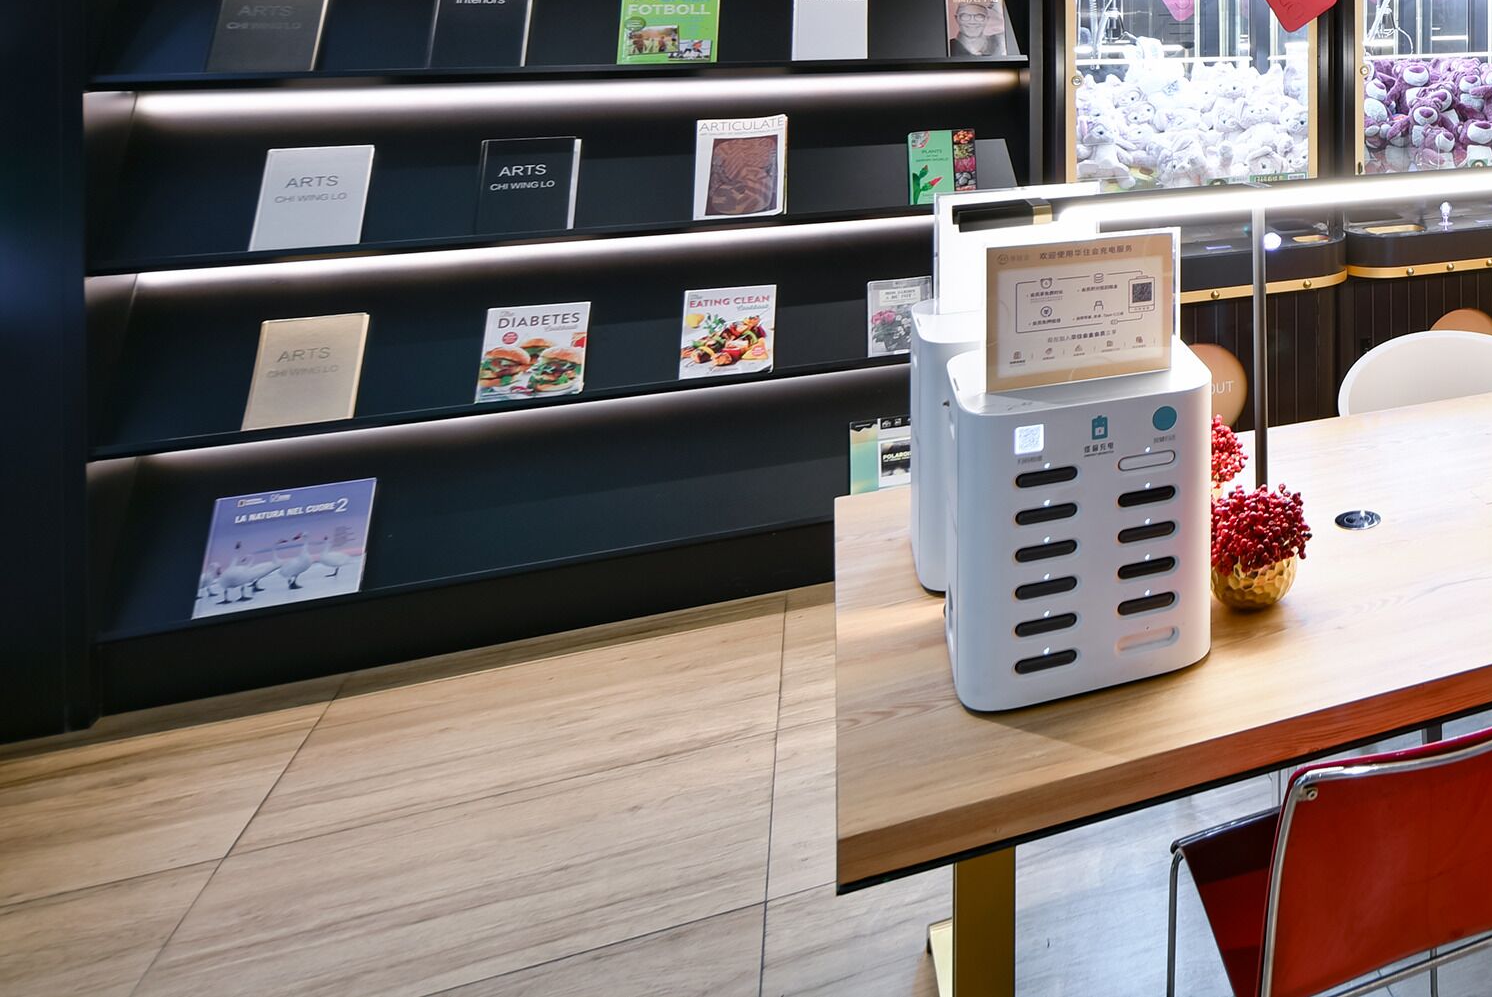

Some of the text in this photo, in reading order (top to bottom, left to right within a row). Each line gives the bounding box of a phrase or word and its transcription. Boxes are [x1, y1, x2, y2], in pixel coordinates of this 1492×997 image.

[238, 5, 293, 17] ARTS
[627, 3, 712, 15] FOTBOLL
[699, 116, 784, 132] ARTICULATE
[498, 164, 547, 177] ARTS
[284, 175, 339, 188] ARTS
[490, 180, 556, 191] CHI WING LO
[274, 192, 348, 204] CHI WING LO
[689, 295, 770, 308] EATING CLEAN
[498, 312, 581, 329] DIABETES
[276, 347, 331, 363] ARTS
[882, 450, 912, 461] POLARO
[234, 497, 349, 524] LA NATURA NEL CUORE 2
